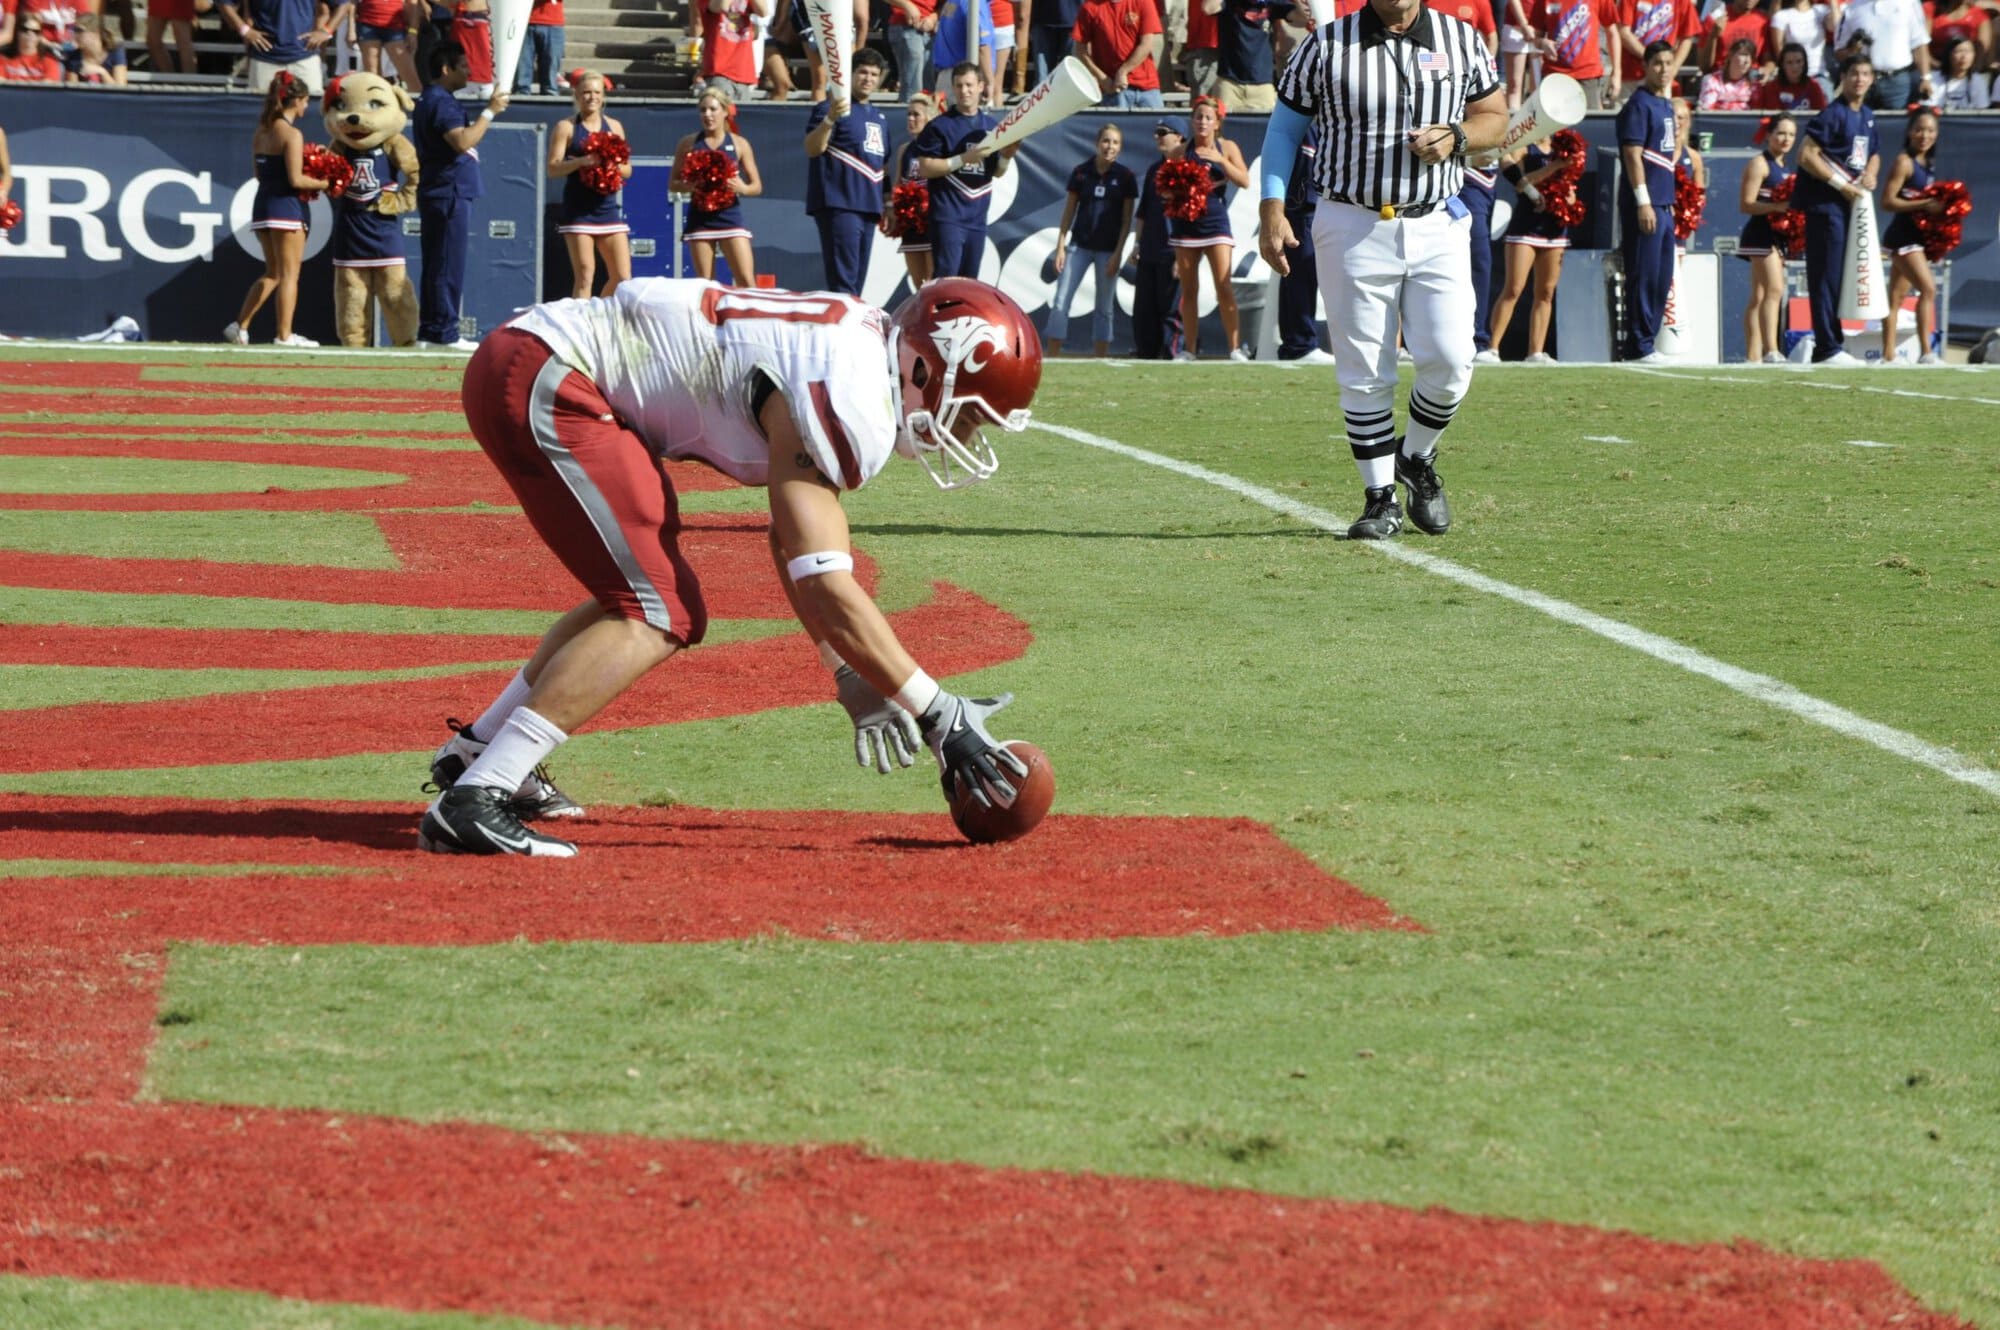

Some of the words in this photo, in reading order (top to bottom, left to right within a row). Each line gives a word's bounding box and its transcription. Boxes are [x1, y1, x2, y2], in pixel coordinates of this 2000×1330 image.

[819, 13, 844, 87] ARIZONA
[863, 121, 885, 157] A
[995, 85, 1051, 139] ARIZONA
[353, 158, 380, 190] A
[1856, 207, 1870, 308] BEARDOWN
